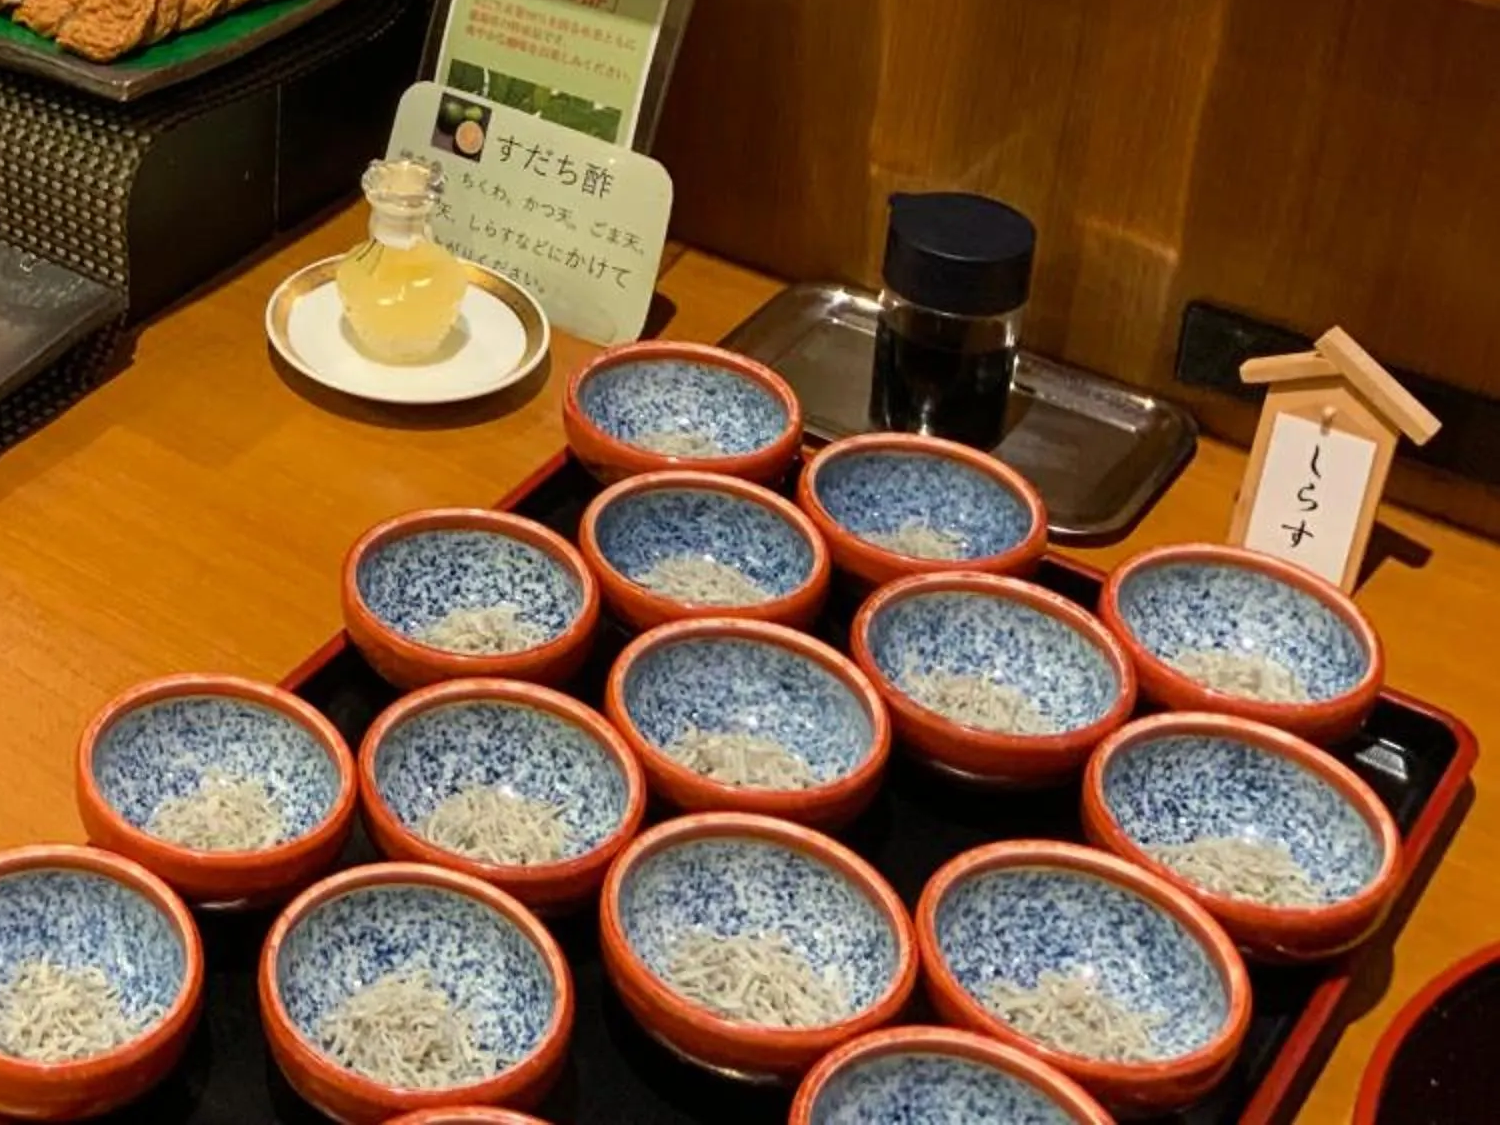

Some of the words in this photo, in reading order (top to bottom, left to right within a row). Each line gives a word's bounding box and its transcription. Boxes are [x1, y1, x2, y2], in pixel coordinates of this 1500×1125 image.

[497, 135, 615, 199] すだち酢
[1281, 443, 1322, 549] しらす
